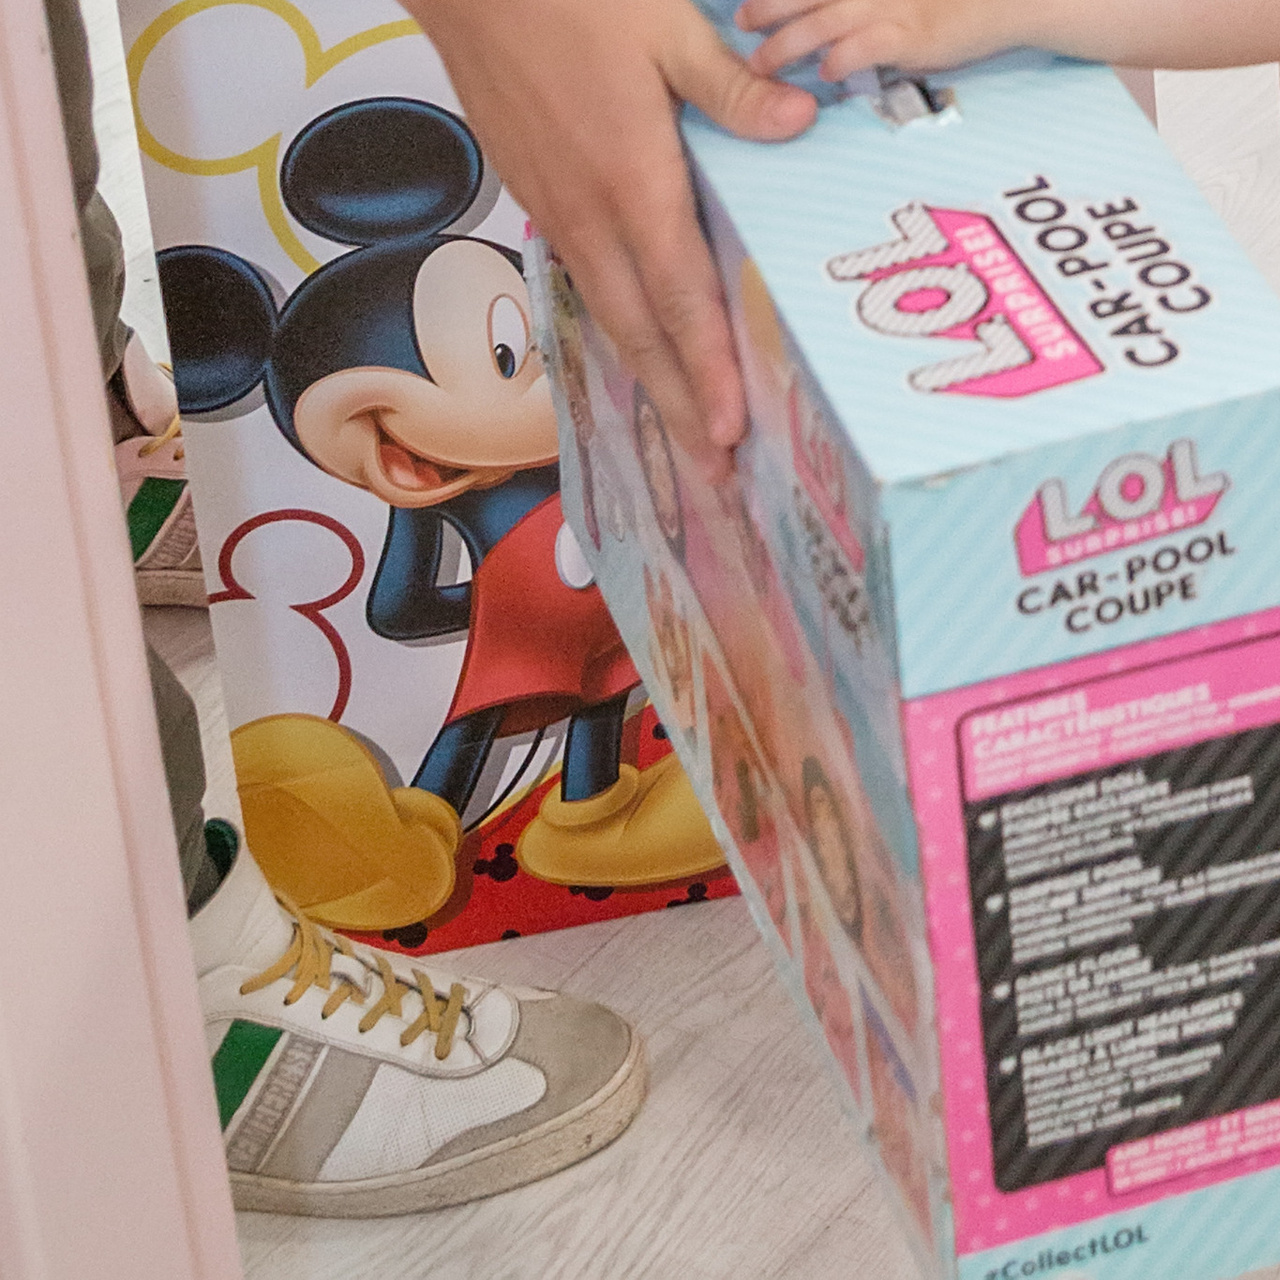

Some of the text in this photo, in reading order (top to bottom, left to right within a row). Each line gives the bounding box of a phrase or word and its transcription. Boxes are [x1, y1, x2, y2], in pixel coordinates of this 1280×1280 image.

[954, 223, 1078, 360] SURPRISE!
[1003, 174, 1180, 368] CAR-POOL
[1086, 196, 1212, 313] COUPE
[1046, 503, 1197, 565] SURPRISE!
[1016, 530, 1235, 616] CAR-POOL
[1065, 575, 1197, 634] COUPE
[971, 692, 1085, 736] FEATURES
[1015, 945, 1139, 990] DANCE FLOOR
